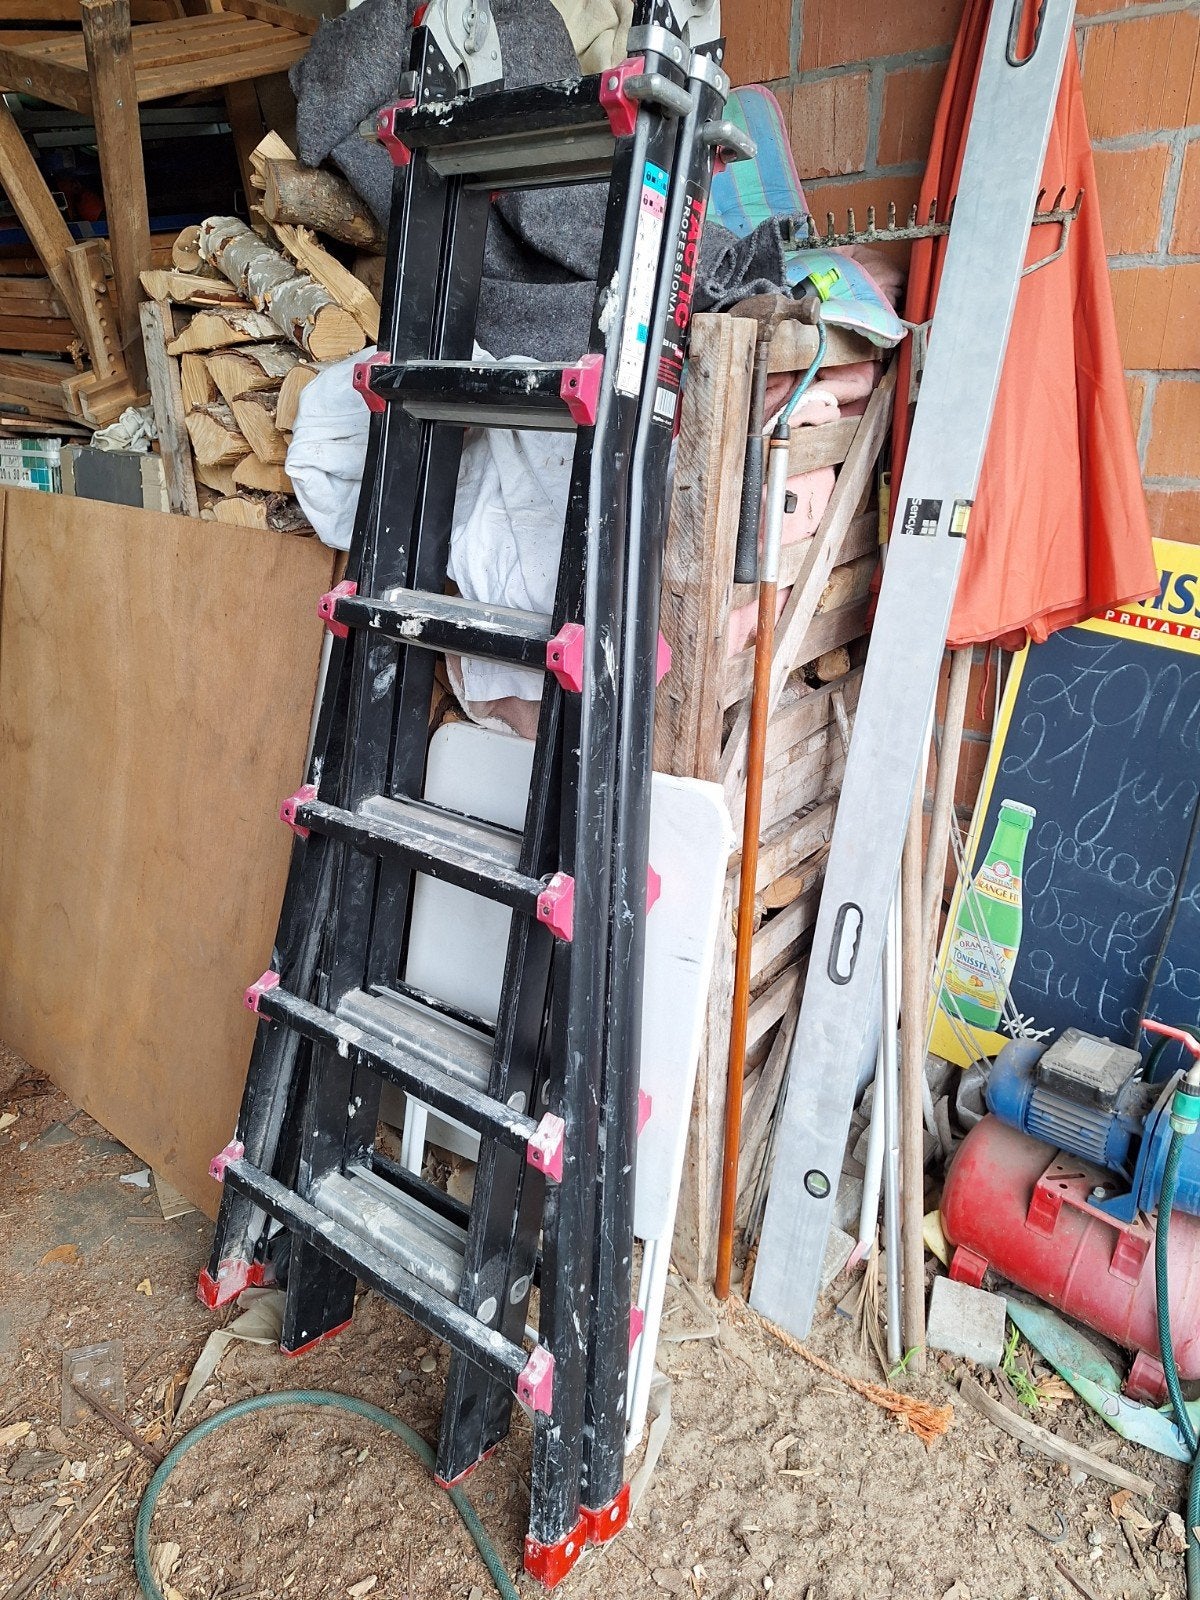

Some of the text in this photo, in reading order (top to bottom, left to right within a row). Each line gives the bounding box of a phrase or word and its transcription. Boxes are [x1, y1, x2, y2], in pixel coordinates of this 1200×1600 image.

[667, 194, 692, 321] PROFESSIONAL
[674, 198, 707, 329] TACTIC
[904, 498, 922, 536] Sencys
[1104, 609, 1200, 640] PRIVATB
[1001, 711, 1096, 798] 21
